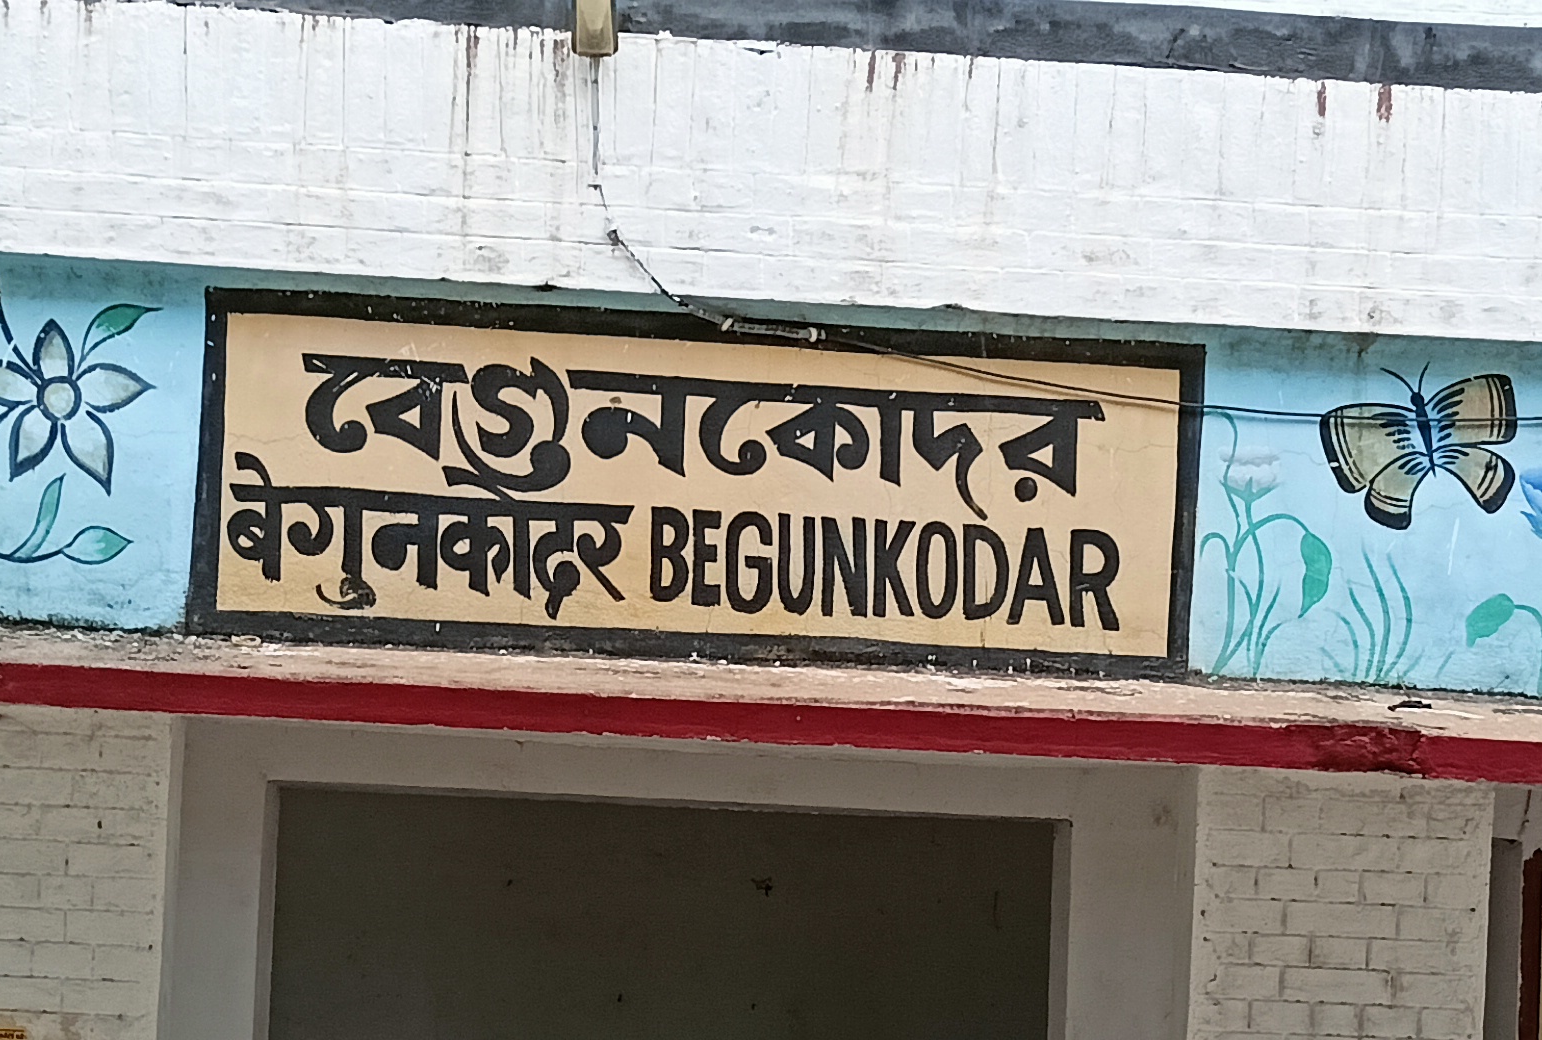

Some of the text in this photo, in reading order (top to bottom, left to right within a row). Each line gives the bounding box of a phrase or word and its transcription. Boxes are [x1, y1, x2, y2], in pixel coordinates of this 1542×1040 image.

[301, 353, 1106, 522] বেগুনকোদর
[226, 452, 636, 620] बेगुनकोदर
[649, 505, 1120, 632] BEGUNKODAR
